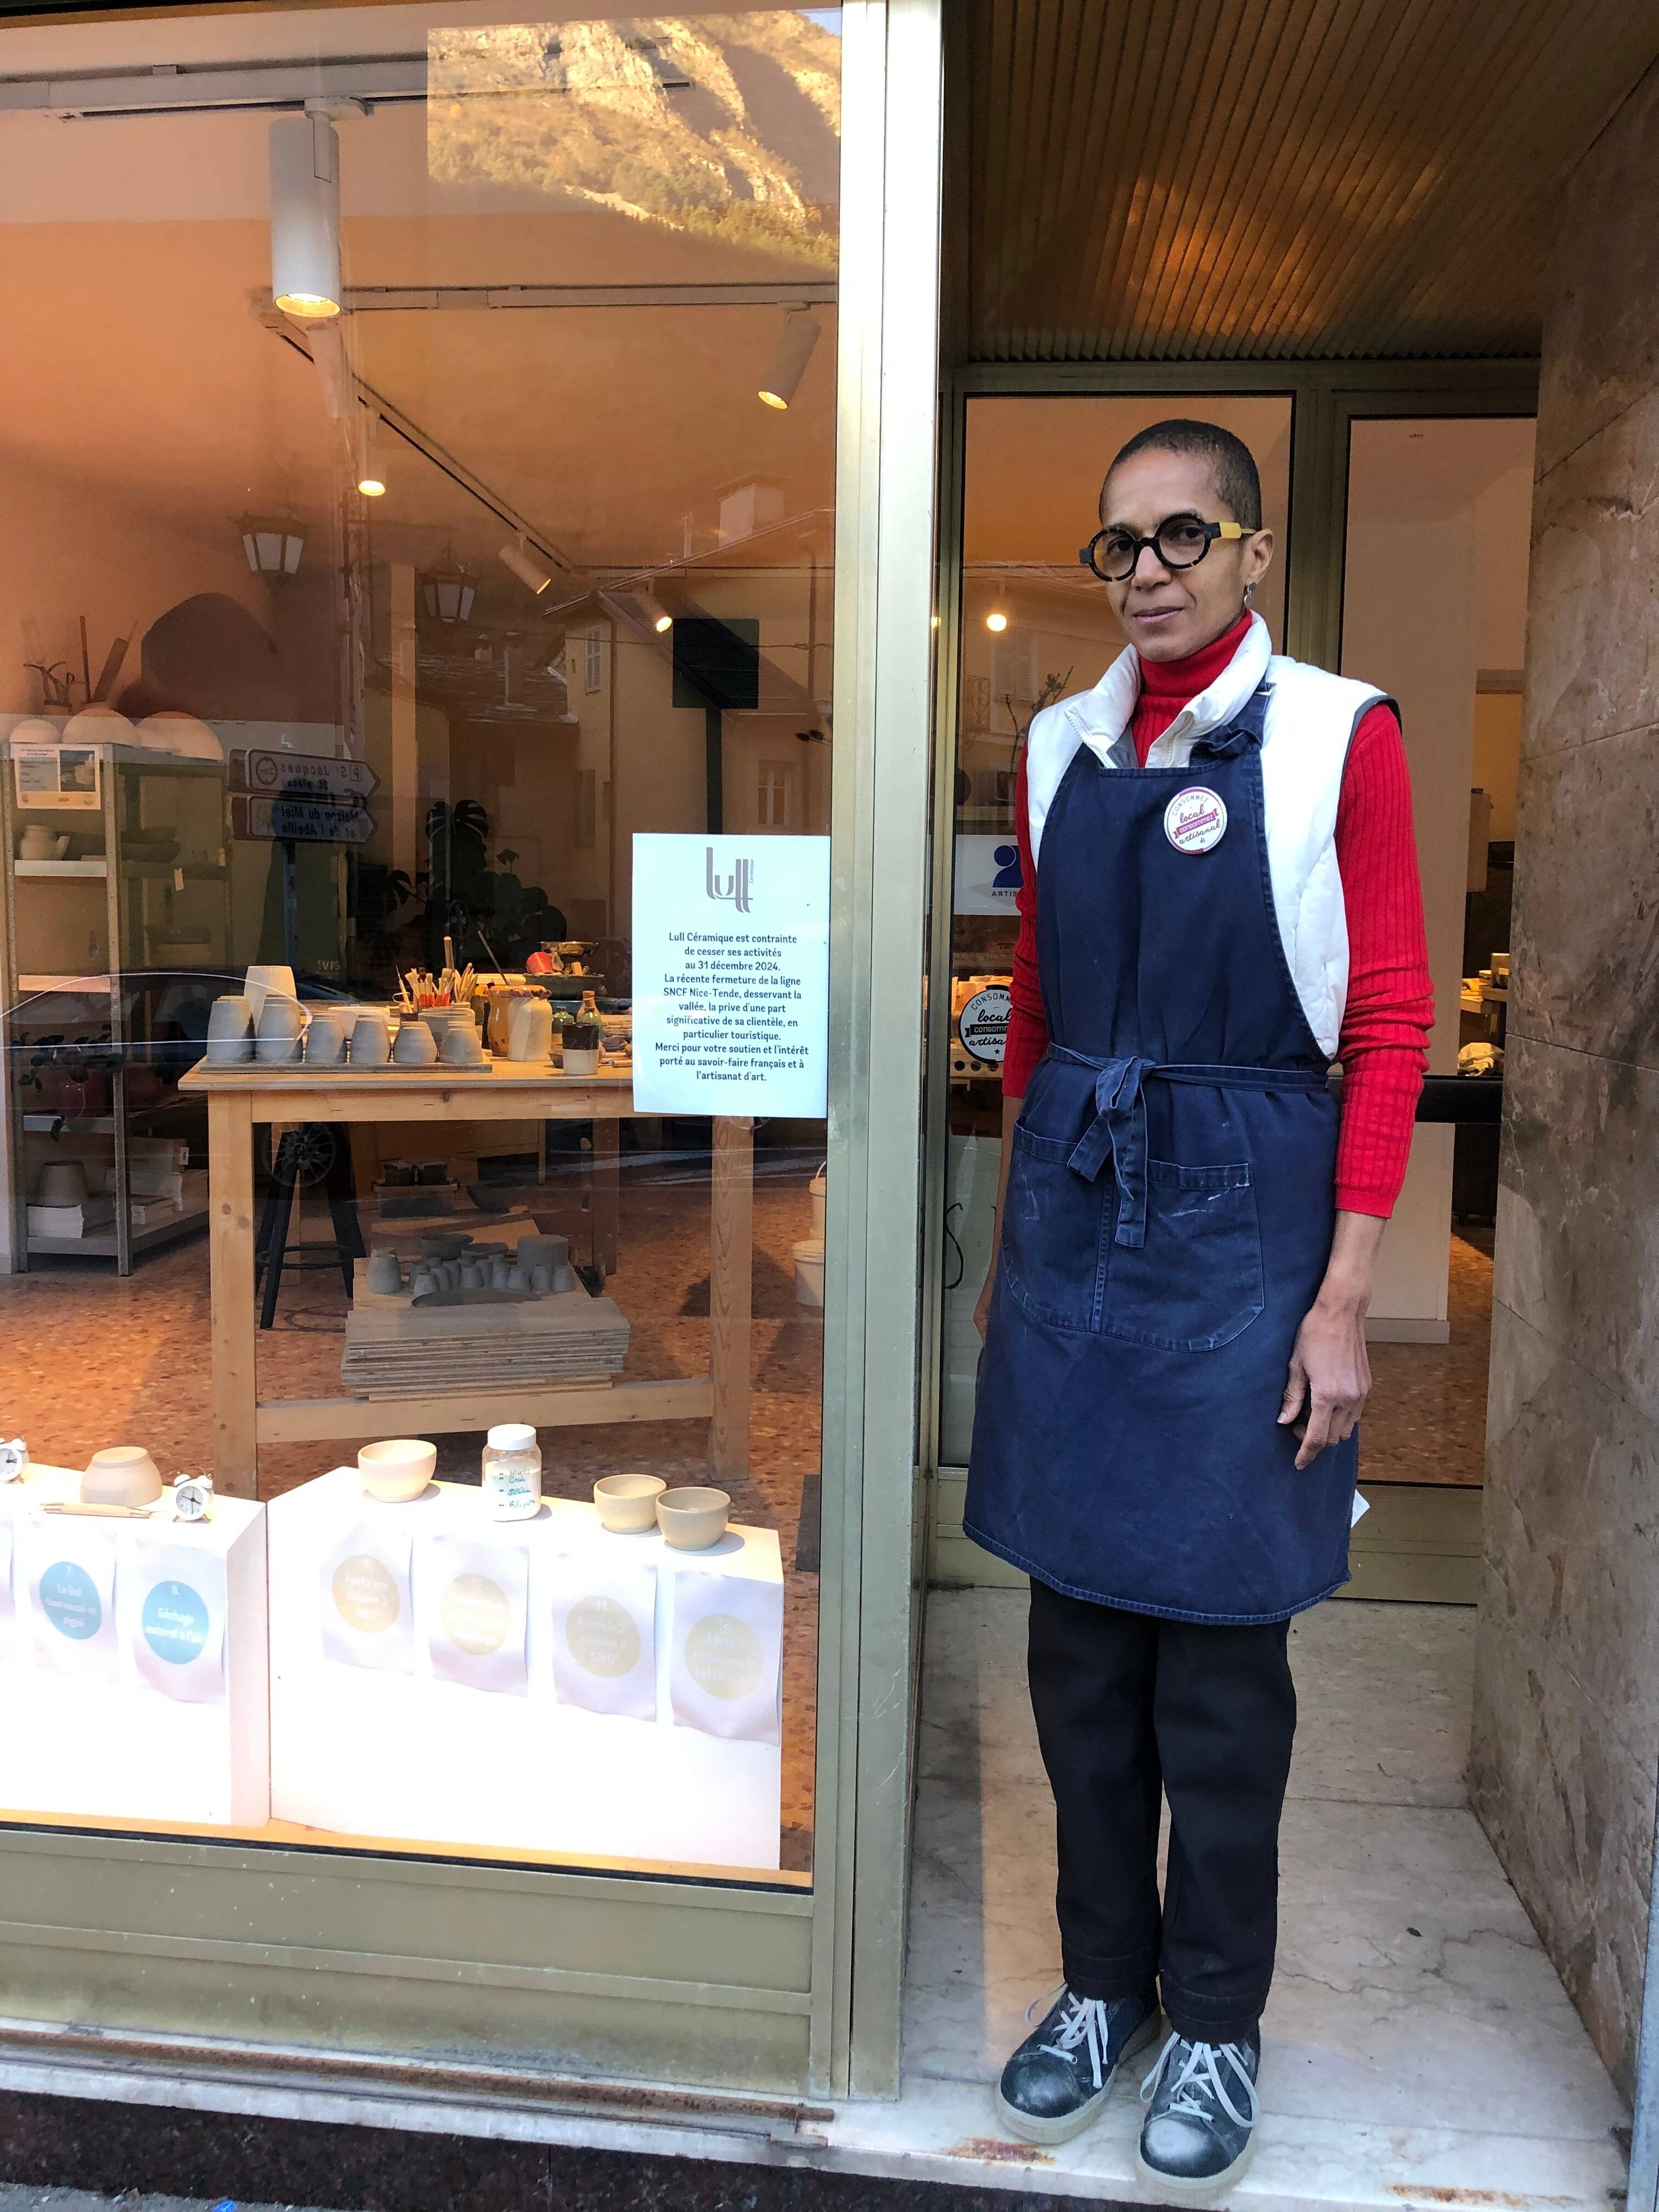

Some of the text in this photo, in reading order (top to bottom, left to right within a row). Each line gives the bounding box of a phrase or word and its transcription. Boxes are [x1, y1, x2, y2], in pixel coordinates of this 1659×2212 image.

[1172, 794, 1209, 816] CONSOMMEZ
[1180, 803, 1205, 823] local
[1179, 818, 1221, 844] artisanal
[669, 932, 797, 945] Lull Céramique est contrainte
[684, 946, 695, 956] de
[743, 947, 782, 957] activités
[698, 960, 708, 969] 31
[710, 960, 753, 970] décembre
[755, 961, 781, 971] 2024.
[664, 973, 801, 988] La récente fermeture de la ligne
[663, 987, 802, 1000] SNCF Nice-Tende, desservant la
[678, 1001, 786, 1015] vallée, la prive d'une part
[666, 1015, 720, 1027] significative
[722, 1015, 733, 1025] de
[746, 1017, 786, 1028] clientèle,
[977, 1008, 1012, 1023] local
[683, 1029, 781, 1043] particulier touristique.
[655, 1042, 809, 1055] Merci pour votre soutien et l'intérêt
[659, 1056, 683, 1068] porté
[697, 1057, 749, 1067] savoir-faire
[751, 1058, 786, 1070] français
[787, 1060, 797, 1069] et
[799, 1059, 804, 1069] à
[696, 1070, 767, 1081] l'artisanat d'art.
